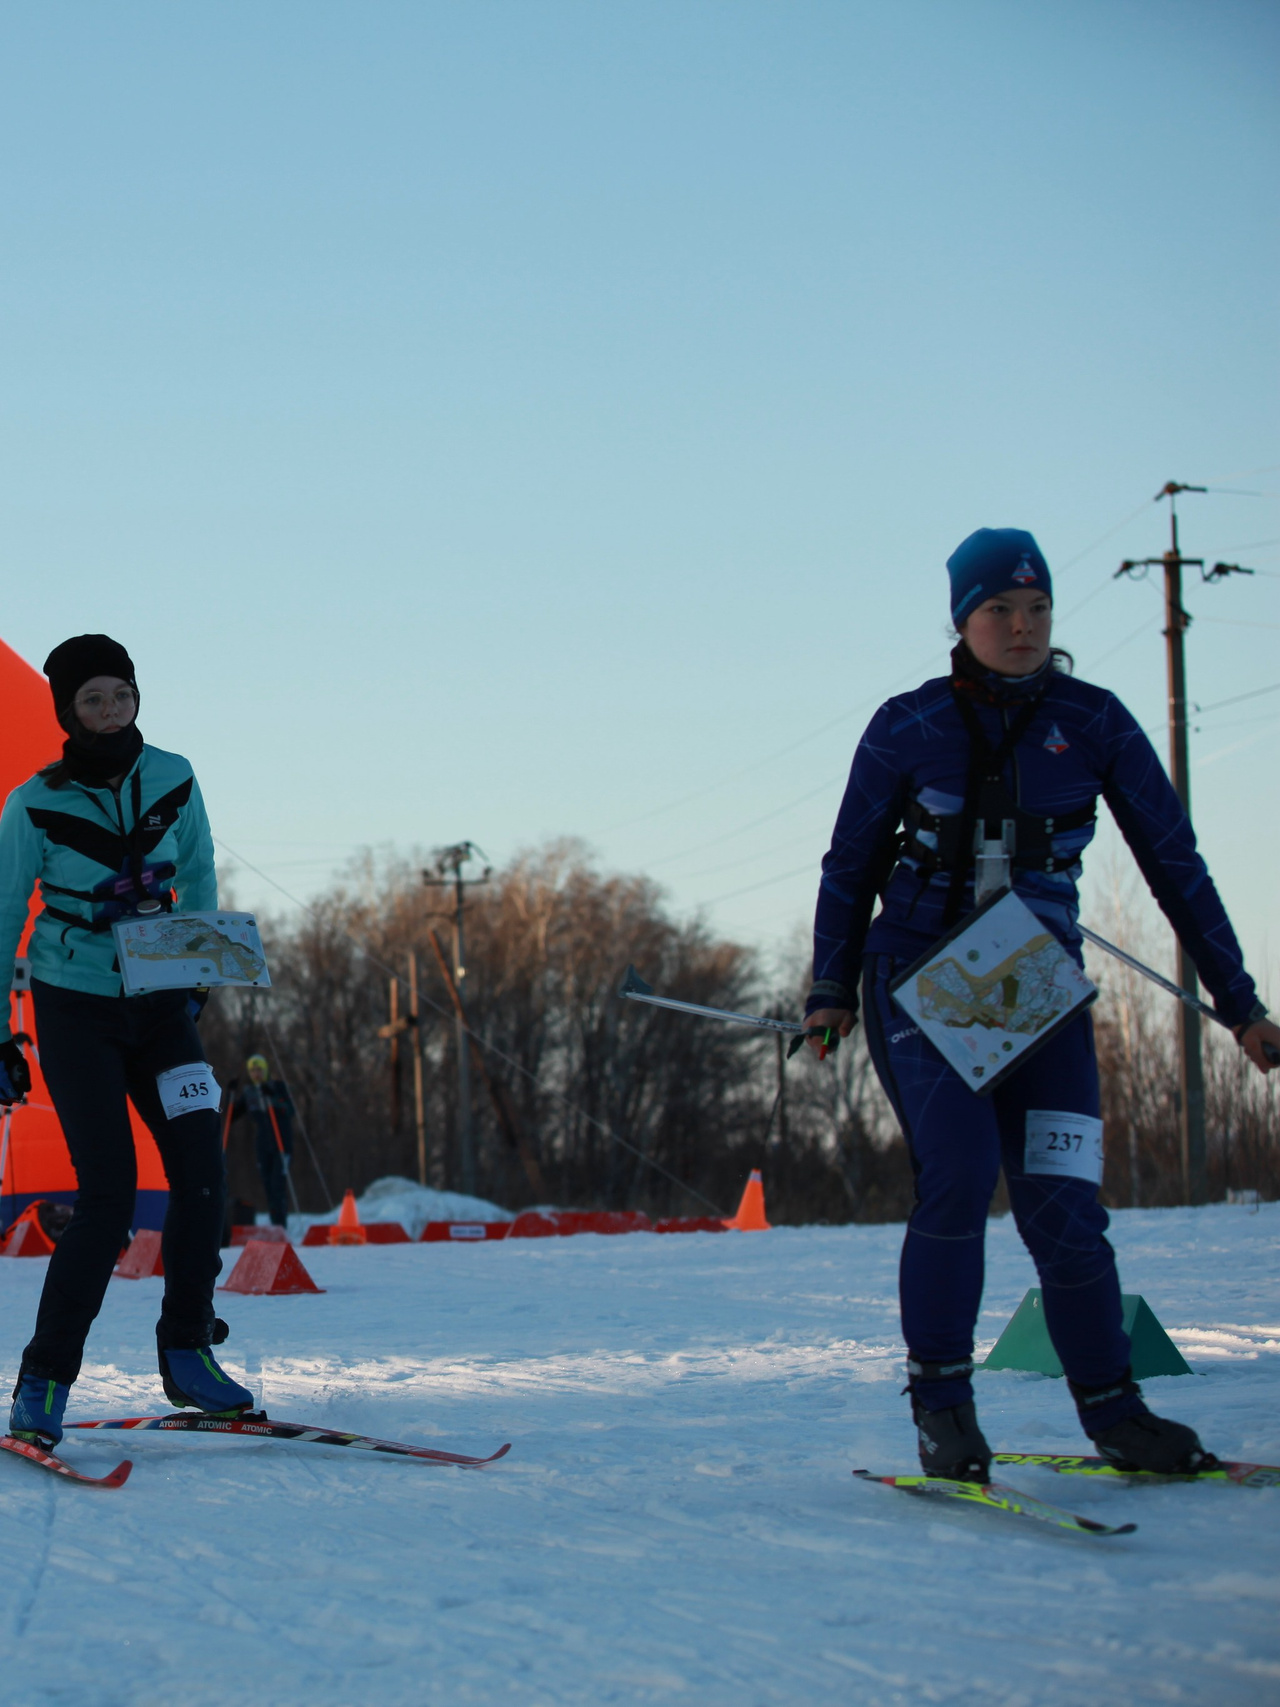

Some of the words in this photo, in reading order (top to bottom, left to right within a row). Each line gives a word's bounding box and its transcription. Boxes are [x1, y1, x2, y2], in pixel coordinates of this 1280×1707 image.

[179, 1082, 209, 1099] 435
[1047, 1131, 1084, 1153] 237
[158, 1420, 188, 1428] ATOMIC
[197, 1420, 232, 1430] ATOMIC
[240, 1424, 272, 1435] ATOMIC
